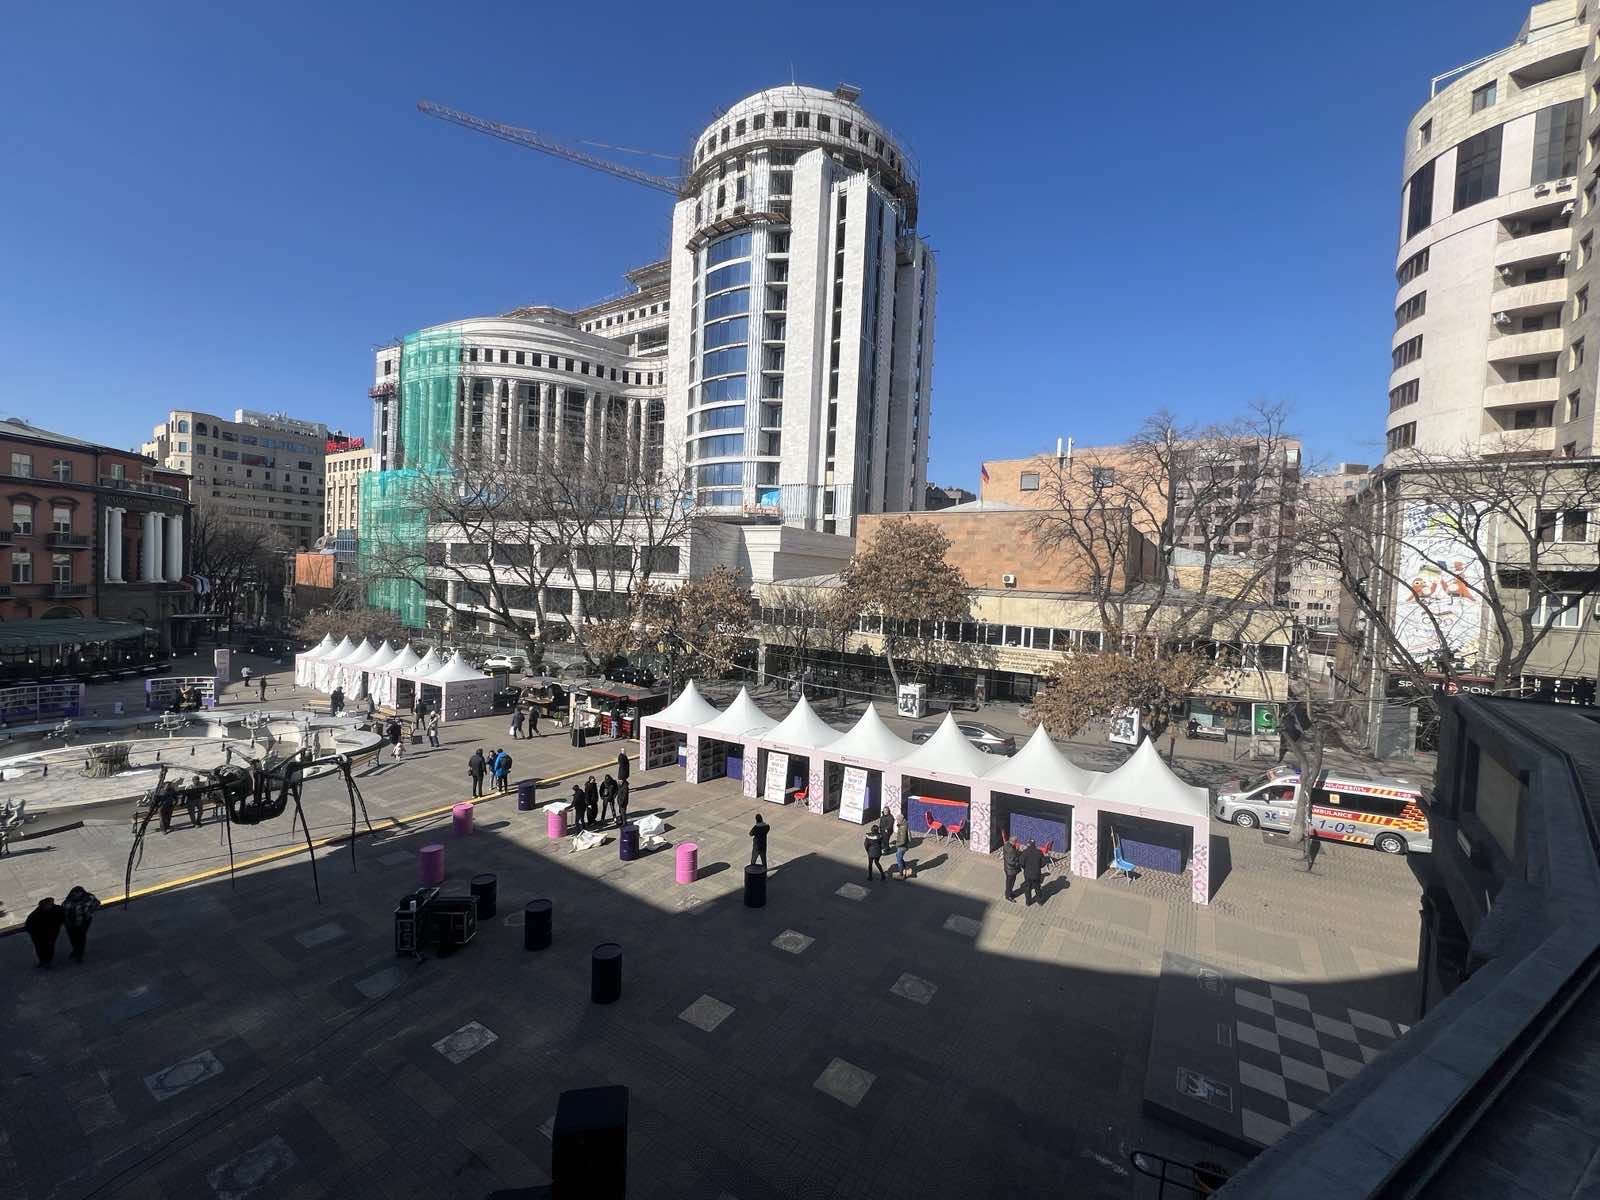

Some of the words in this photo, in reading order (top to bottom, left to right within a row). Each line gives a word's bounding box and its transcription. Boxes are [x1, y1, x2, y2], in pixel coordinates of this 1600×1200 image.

[1398, 680, 1440, 690] SPT
[1312, 808, 1353, 819] MBULANCE
[1319, 819, 1356, 834] 1-03
